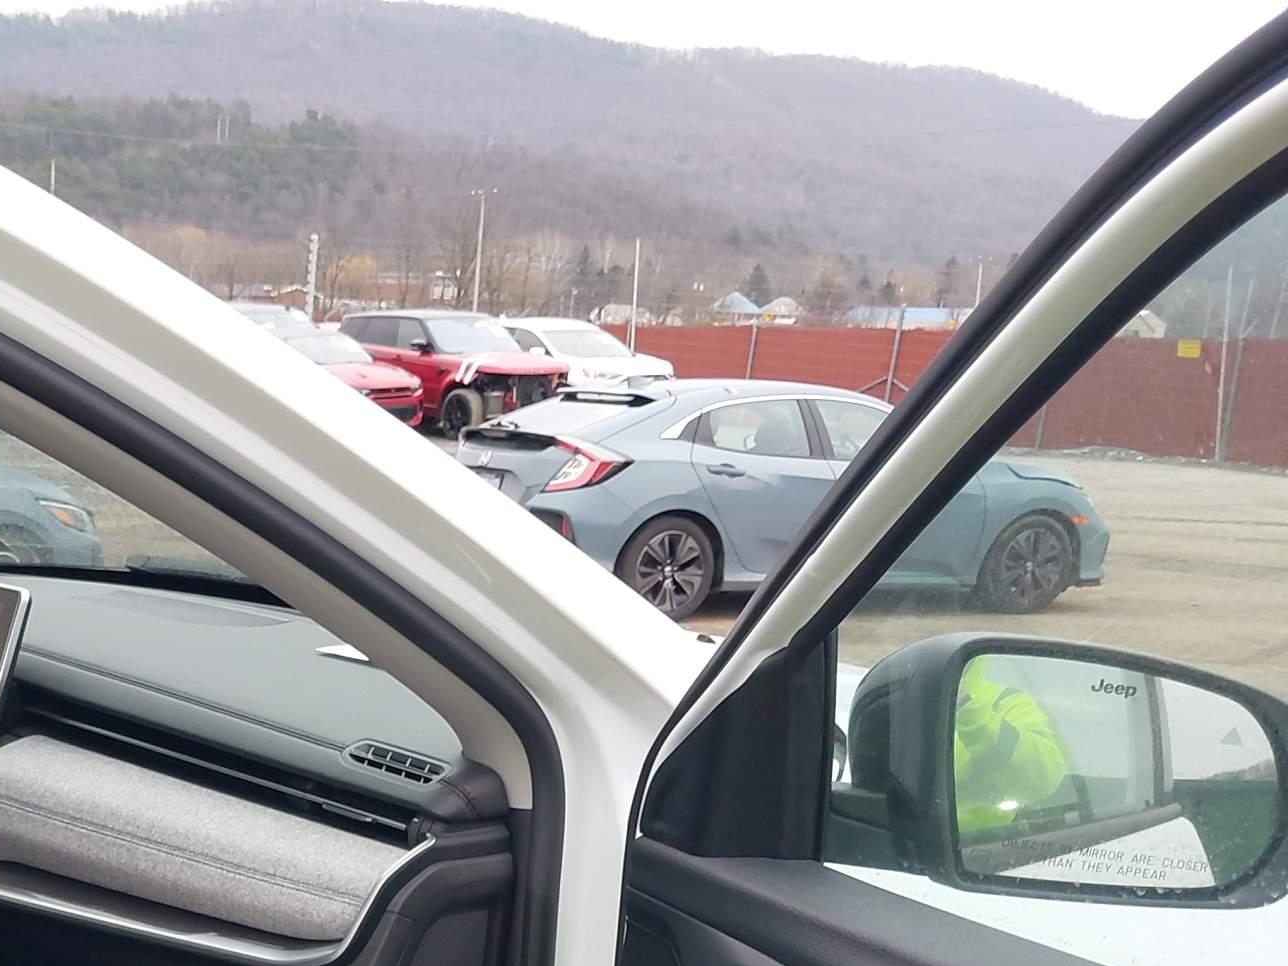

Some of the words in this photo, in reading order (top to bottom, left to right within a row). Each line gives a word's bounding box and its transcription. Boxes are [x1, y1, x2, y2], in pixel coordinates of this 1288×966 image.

[1091, 678, 1138, 699] Jeep
[1040, 857, 1074, 869] THAN
[1082, 861, 1113, 875] THEY
[1116, 865, 1168, 881] APPEAR
[1079, 846, 1125, 862] MIRROR
[1131, 853, 1154, 866] ARE
[1162, 857, 1208, 873] CLOSER
